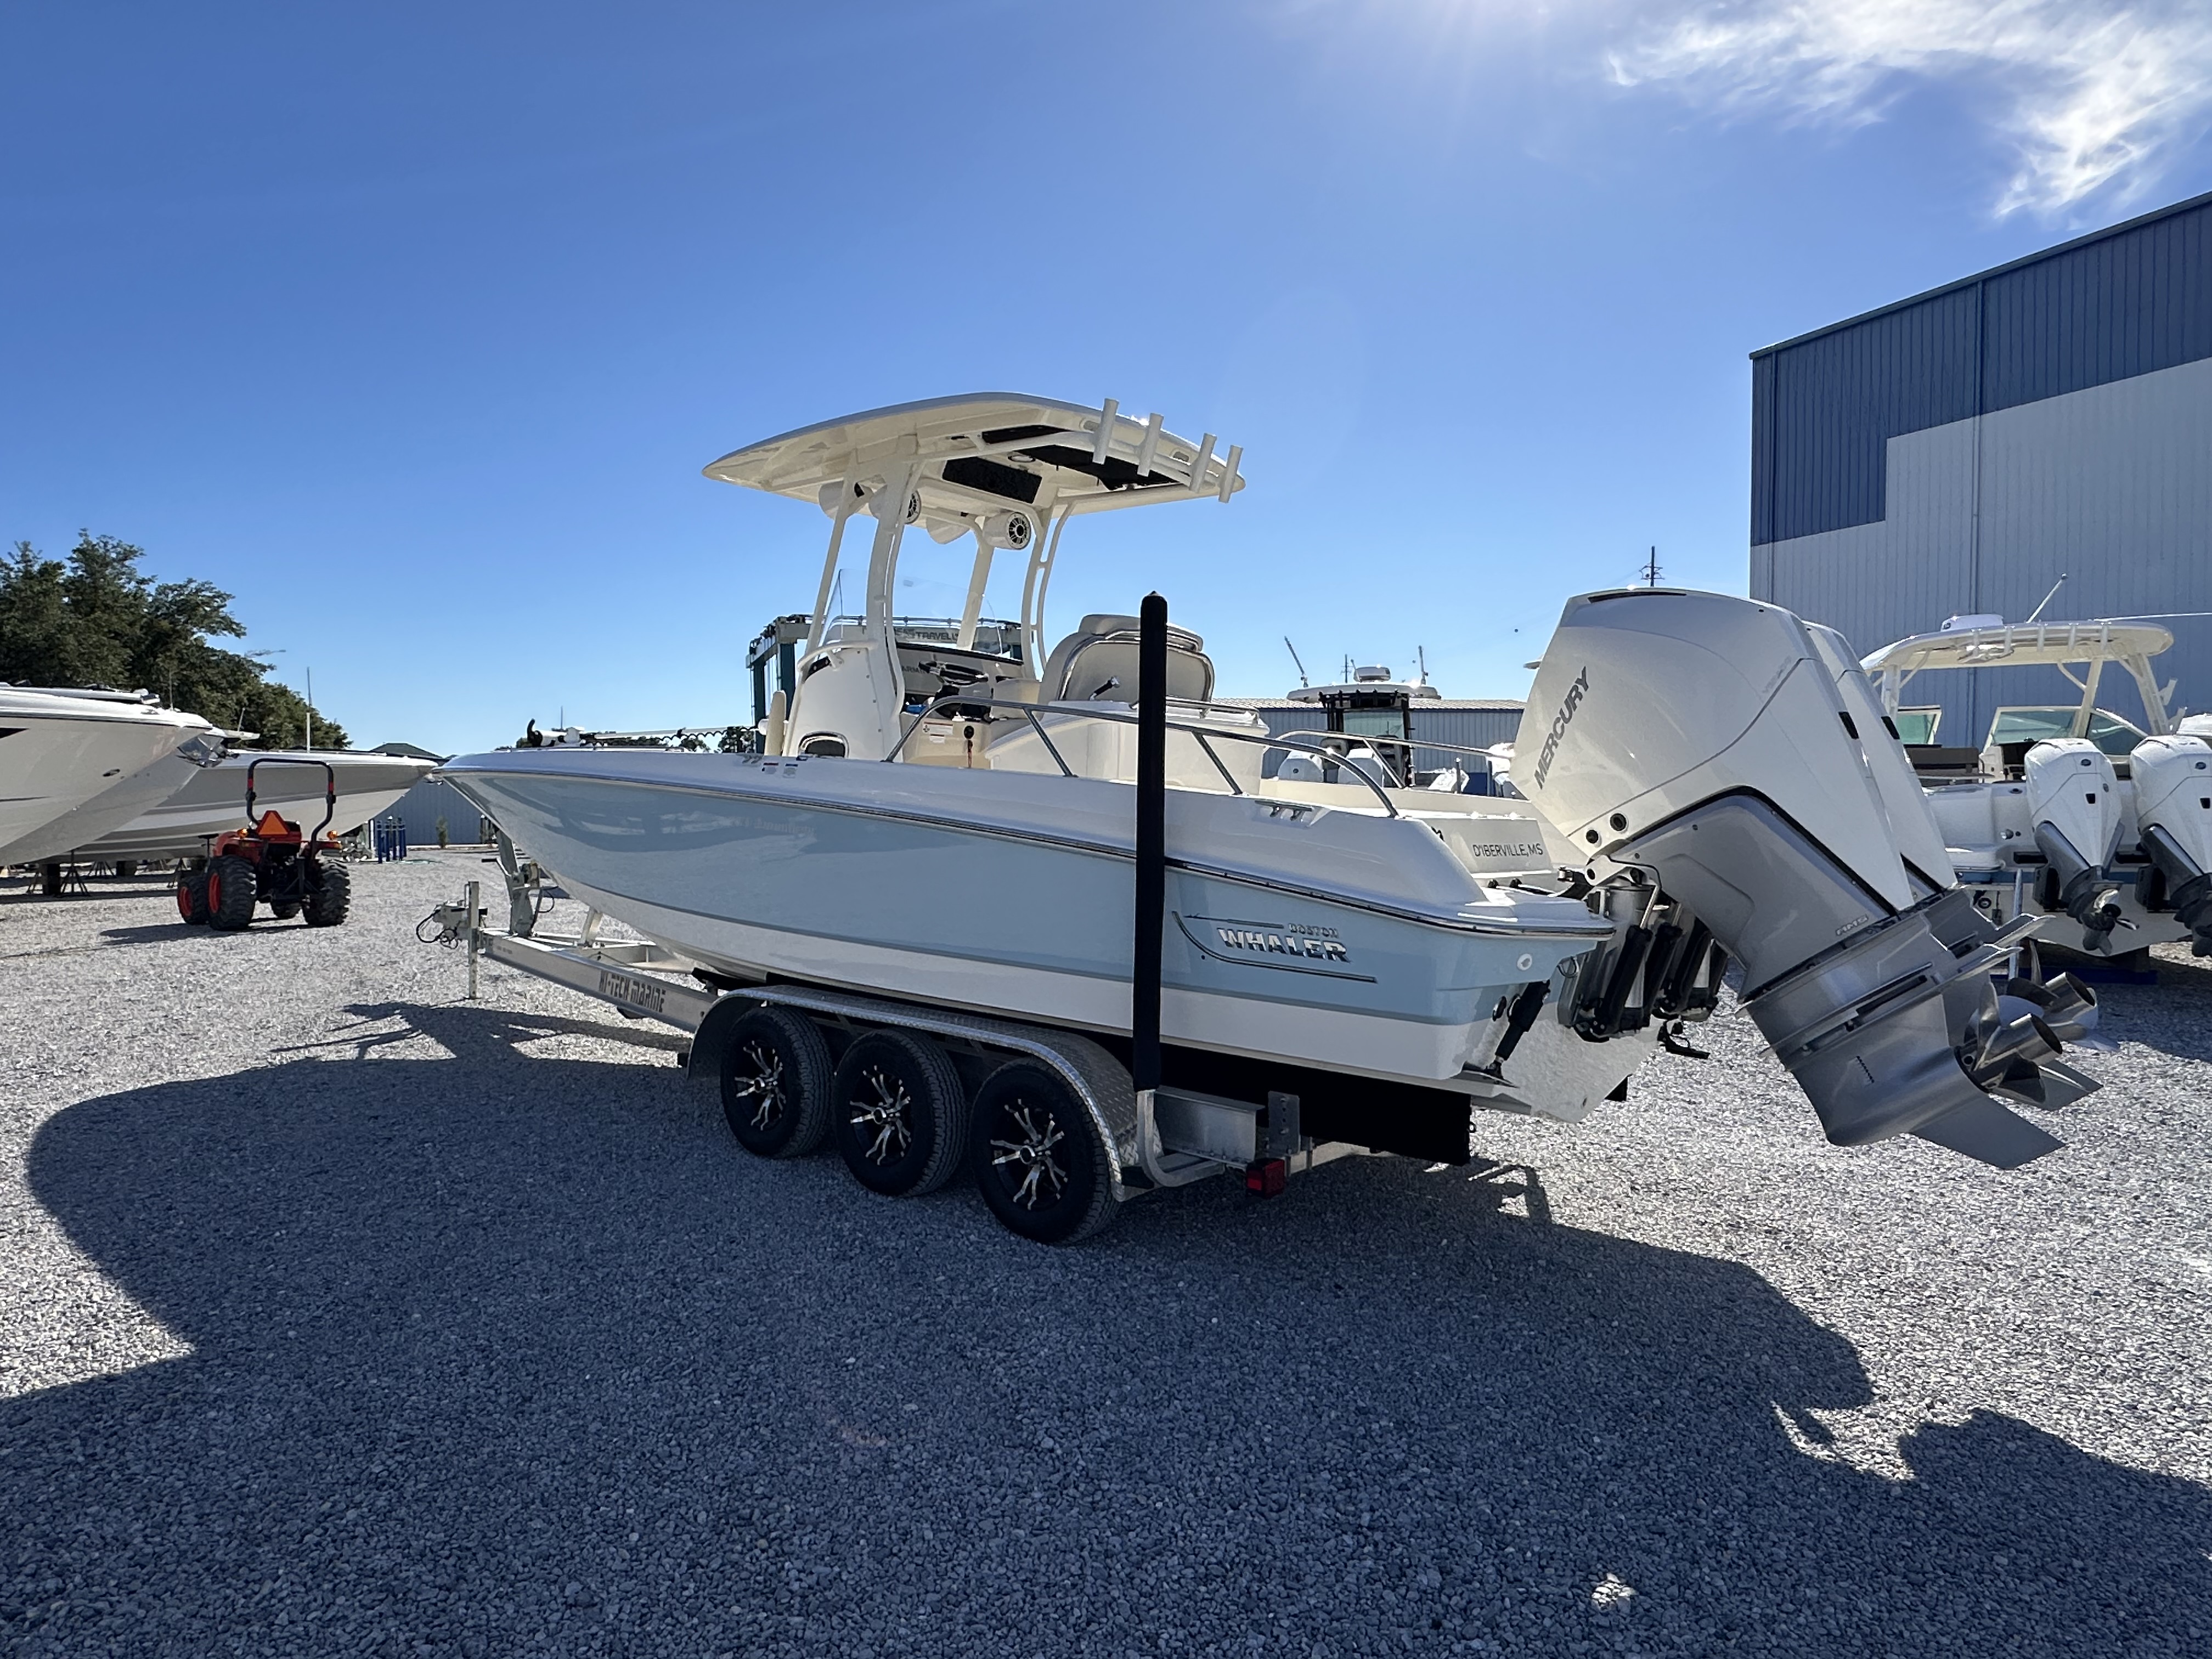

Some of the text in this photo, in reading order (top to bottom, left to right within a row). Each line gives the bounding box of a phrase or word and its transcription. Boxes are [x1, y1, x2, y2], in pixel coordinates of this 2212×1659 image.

[1534, 666, 1589, 789] MERCURY
[1528, 843, 1543, 855] MS
[1216, 927, 1351, 963] WHALER
[1289, 923, 1339, 939] BOSTON
[630, 980, 665, 1012] MARINE
